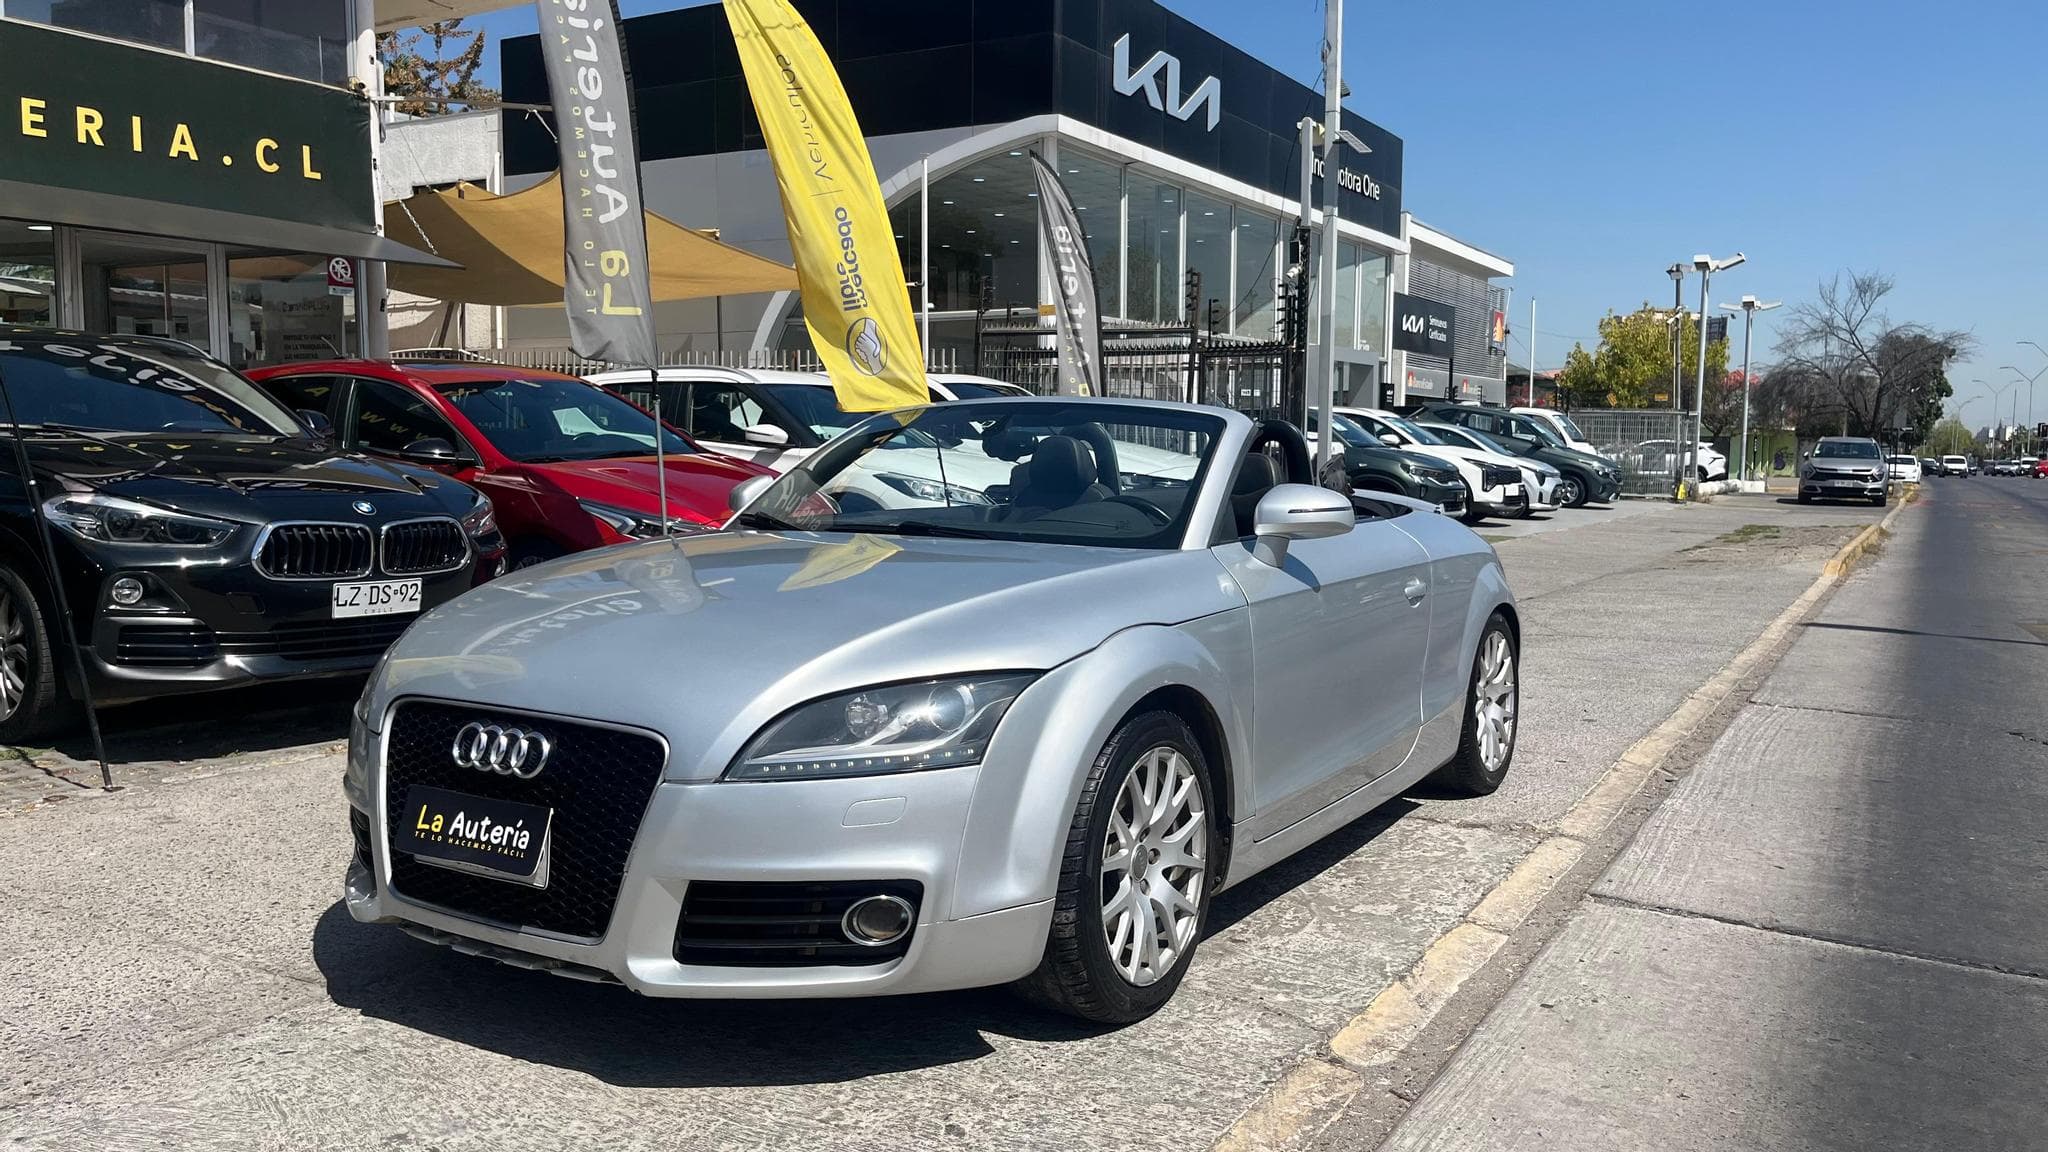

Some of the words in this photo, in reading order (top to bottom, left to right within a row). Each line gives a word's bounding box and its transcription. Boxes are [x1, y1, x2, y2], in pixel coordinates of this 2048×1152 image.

[1113, 32, 1221, 133] KIA
[1311, 150, 1361, 193] Inotora
[1362, 173, 1381, 201] One
[1402, 313, 1424, 335] KIA
[364, 607, 393, 615] CHILE
[414, 831, 426, 839] TE
[431, 834, 442, 842] LO
[448, 837, 492, 852] HACEMOS
[416, 804, 444, 833] La
[448, 810, 530, 850] Autería
